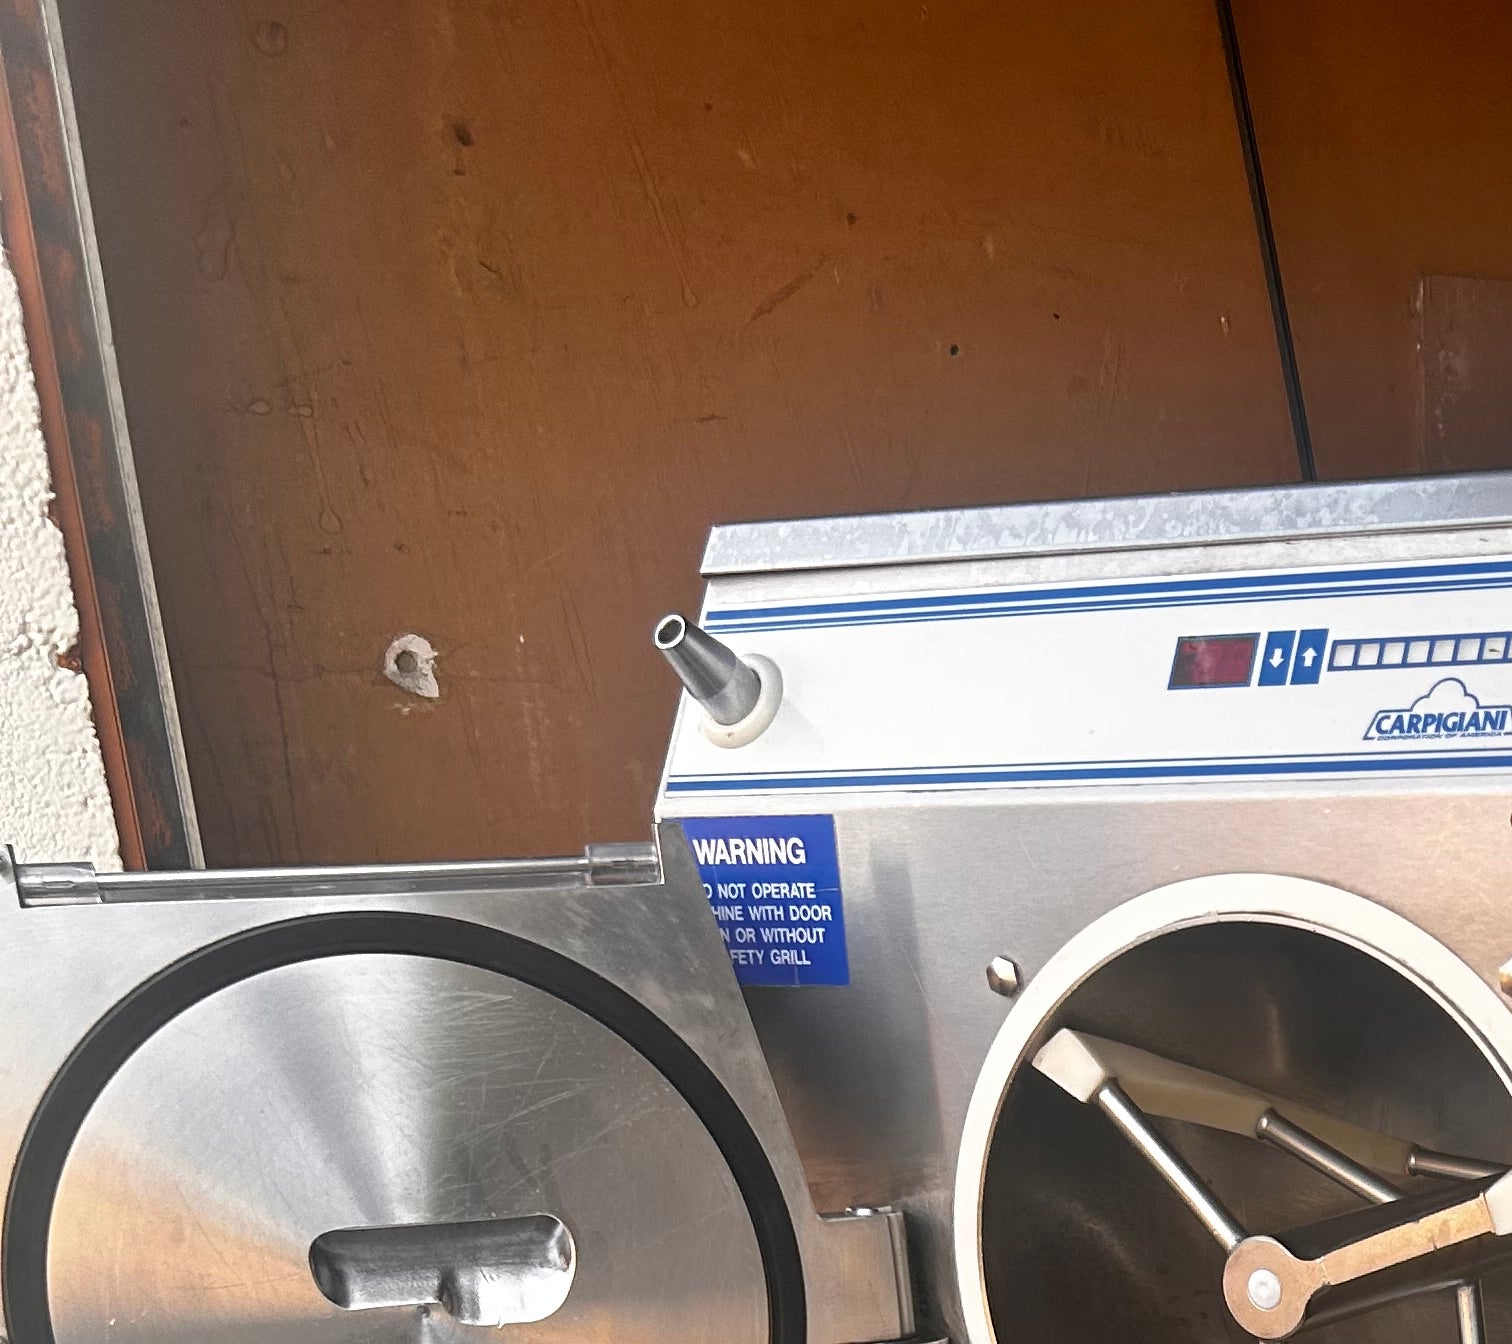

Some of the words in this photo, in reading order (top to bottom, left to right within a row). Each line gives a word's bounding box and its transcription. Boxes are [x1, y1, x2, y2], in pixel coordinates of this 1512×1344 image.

[1375, 710, 1508, 735] CARPIGIANI
[693, 837, 806, 865] WARNING
[703, 883, 713, 899] O
[718, 883, 746, 899] NOT
[751, 882, 817, 899] OPERATE
[712, 906, 745, 921] HINE
[749, 905, 785, 921] WITH
[789, 904, 833, 921] DOOR
[735, 927, 756, 943] OR
[760, 927, 826, 943] WITHOUT
[730, 949, 764, 965] FETY
[770, 949, 812, 965] GRILL
